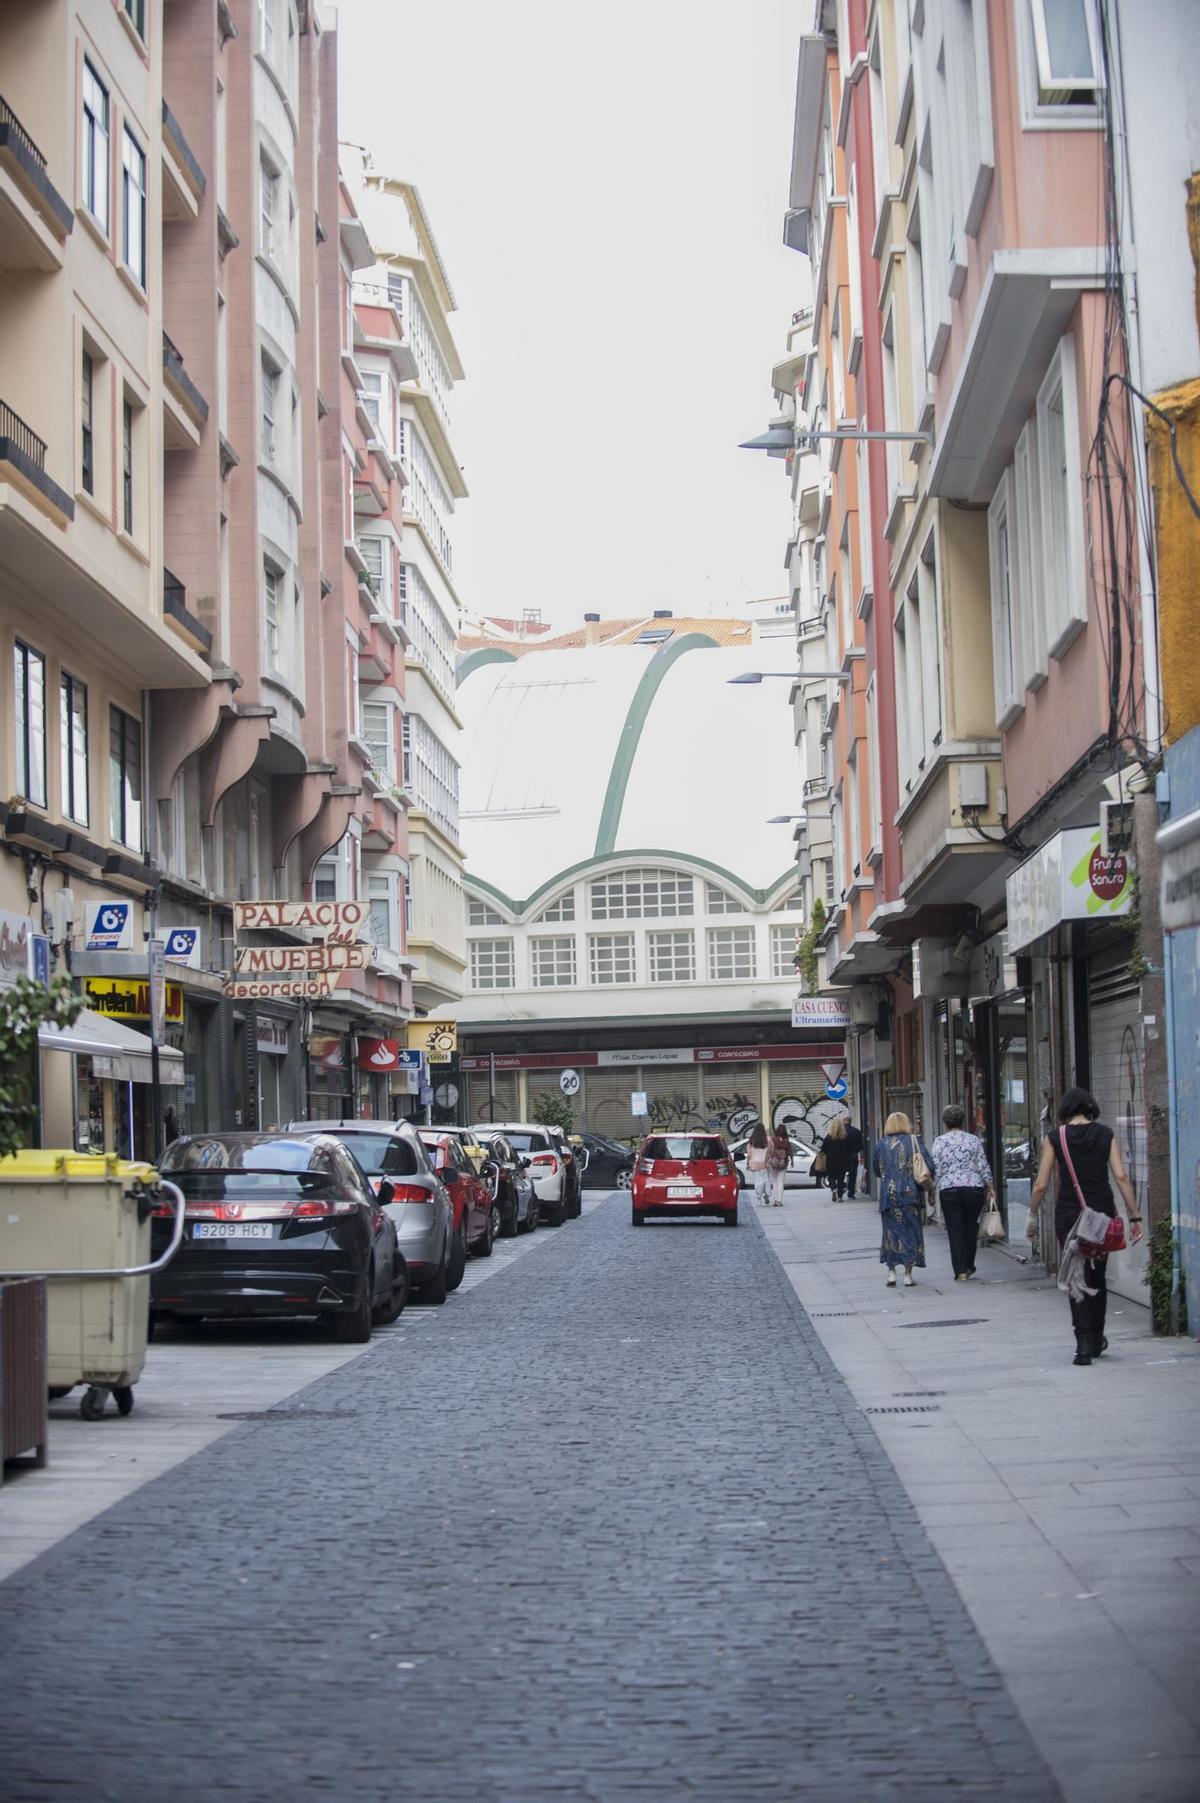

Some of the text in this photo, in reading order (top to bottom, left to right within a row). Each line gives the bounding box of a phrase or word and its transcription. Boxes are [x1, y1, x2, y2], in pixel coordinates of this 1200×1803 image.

[240, 902, 361, 928] PALACIO
[327, 924, 353, 945] del
[248, 946, 364, 971] MUEBLE
[795, 1001, 816, 1014] CASA
[562, 1076, 578, 1089] 20
[201, 1225, 268, 1236] 9209 HCY
